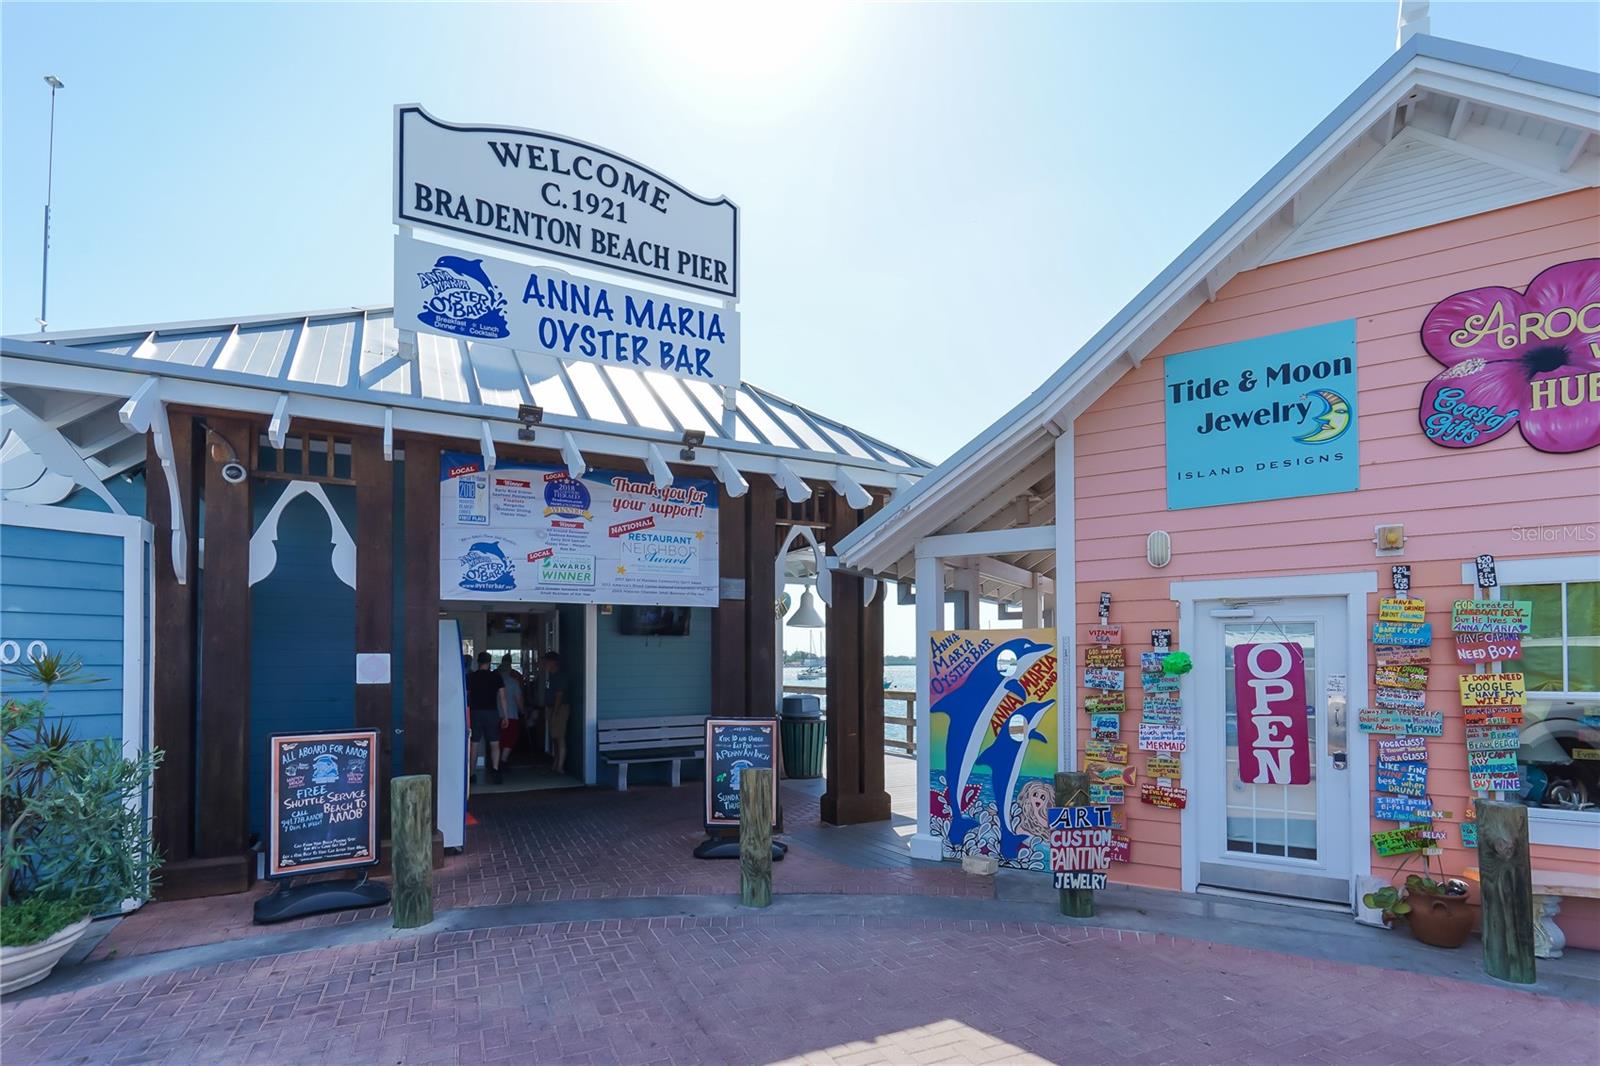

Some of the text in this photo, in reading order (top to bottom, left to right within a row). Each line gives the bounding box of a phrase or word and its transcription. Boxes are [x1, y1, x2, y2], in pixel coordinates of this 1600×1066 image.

[487, 141, 671, 214] WELCOME
[541, 182, 628, 224] C.1921
[414, 182, 729, 285] BRADENTON BEACH PIER
[416, 268, 454, 289] ANNA
[430, 291, 489, 312] OYSTER
[453, 300, 486, 318] BAR
[522, 273, 726, 344] ANNA MARIA
[434, 321, 456, 331] Dinner
[480, 323, 500, 333] Lunch
[539, 316, 714, 379] OYSTER BAR
[1168, 356, 1352, 404] Tide & Moon
[1196, 400, 1312, 434] Jewelry
[1433, 387, 1520, 433] Coastal
[1426, 413, 1480, 444] Gifts
[451, 466, 476, 475] LOCAL
[1177, 452, 1344, 481] ISLAND DESIGNS
[611, 477, 707, 505] Thank you for
[613, 498, 704, 518] your support!
[610, 519, 653, 534] NATIONAL
[628, 532, 692, 545] RESTAURANT
[529, 550, 551, 560] LOCAL
[621, 542, 697, 557] NEIGHBOR
[644, 552, 692, 564] Award
[466, 563, 503, 579] OYSTER
[552, 562, 592, 571] AWARDS
[480, 570, 502, 581] BAR
[542, 571, 591, 582] WINNER
[1475, 601, 1514, 609] created
[1454, 623, 1520, 632] ANNA MARIA
[930, 632, 961, 659] ANNA
[1456, 633, 1484, 644] HAVE
[933, 639, 974, 676] MARIA
[1458, 649, 1486, 659] NEED
[931, 638, 995, 694] OYSTER BAR
[1499, 673, 1522, 681] NEED
[1033, 671, 1057, 701] ISLAND
[1467, 682, 1513, 692] GOOGLE
[991, 654, 1057, 737] ANNA MARIA
[1476, 691, 1500, 699] HAVE
[1476, 697, 1514, 705] WIFE!
[1247, 643, 1294, 784] OPEN
[1146, 741, 1186, 751] MERMAID
[1399, 738, 1424, 747] CLASS?
[282, 744, 368, 765] ALL ABOARD FOR AMOB
[1402, 752, 1428, 761] GLASS!
[1471, 751, 1514, 760] YOU CAN'T
[1378, 761, 1427, 776] LIKE FINE
[1470, 763, 1516, 773] HAPPINESS
[1377, 777, 1425, 790] best when
[1472, 772, 1487, 780] BUT
[296, 784, 328, 799] FREE
[1473, 779, 1521, 790] BUY WINE
[283, 789, 366, 810] SHUTTLE SERVICE
[717, 792, 740, 802] SUNDA
[323, 798, 367, 814] BEACH TO
[291, 810, 309, 818] CALL
[329, 808, 363, 824] AMOB
[1050, 806, 1111, 828] ART
[1416, 810, 1444, 818] RELAX
[1050, 829, 1112, 847] CUSTOM
[1422, 831, 1446, 839] RELAX
[1050, 846, 1111, 871] PAINTING
[1055, 873, 1107, 889] JEWELRY
